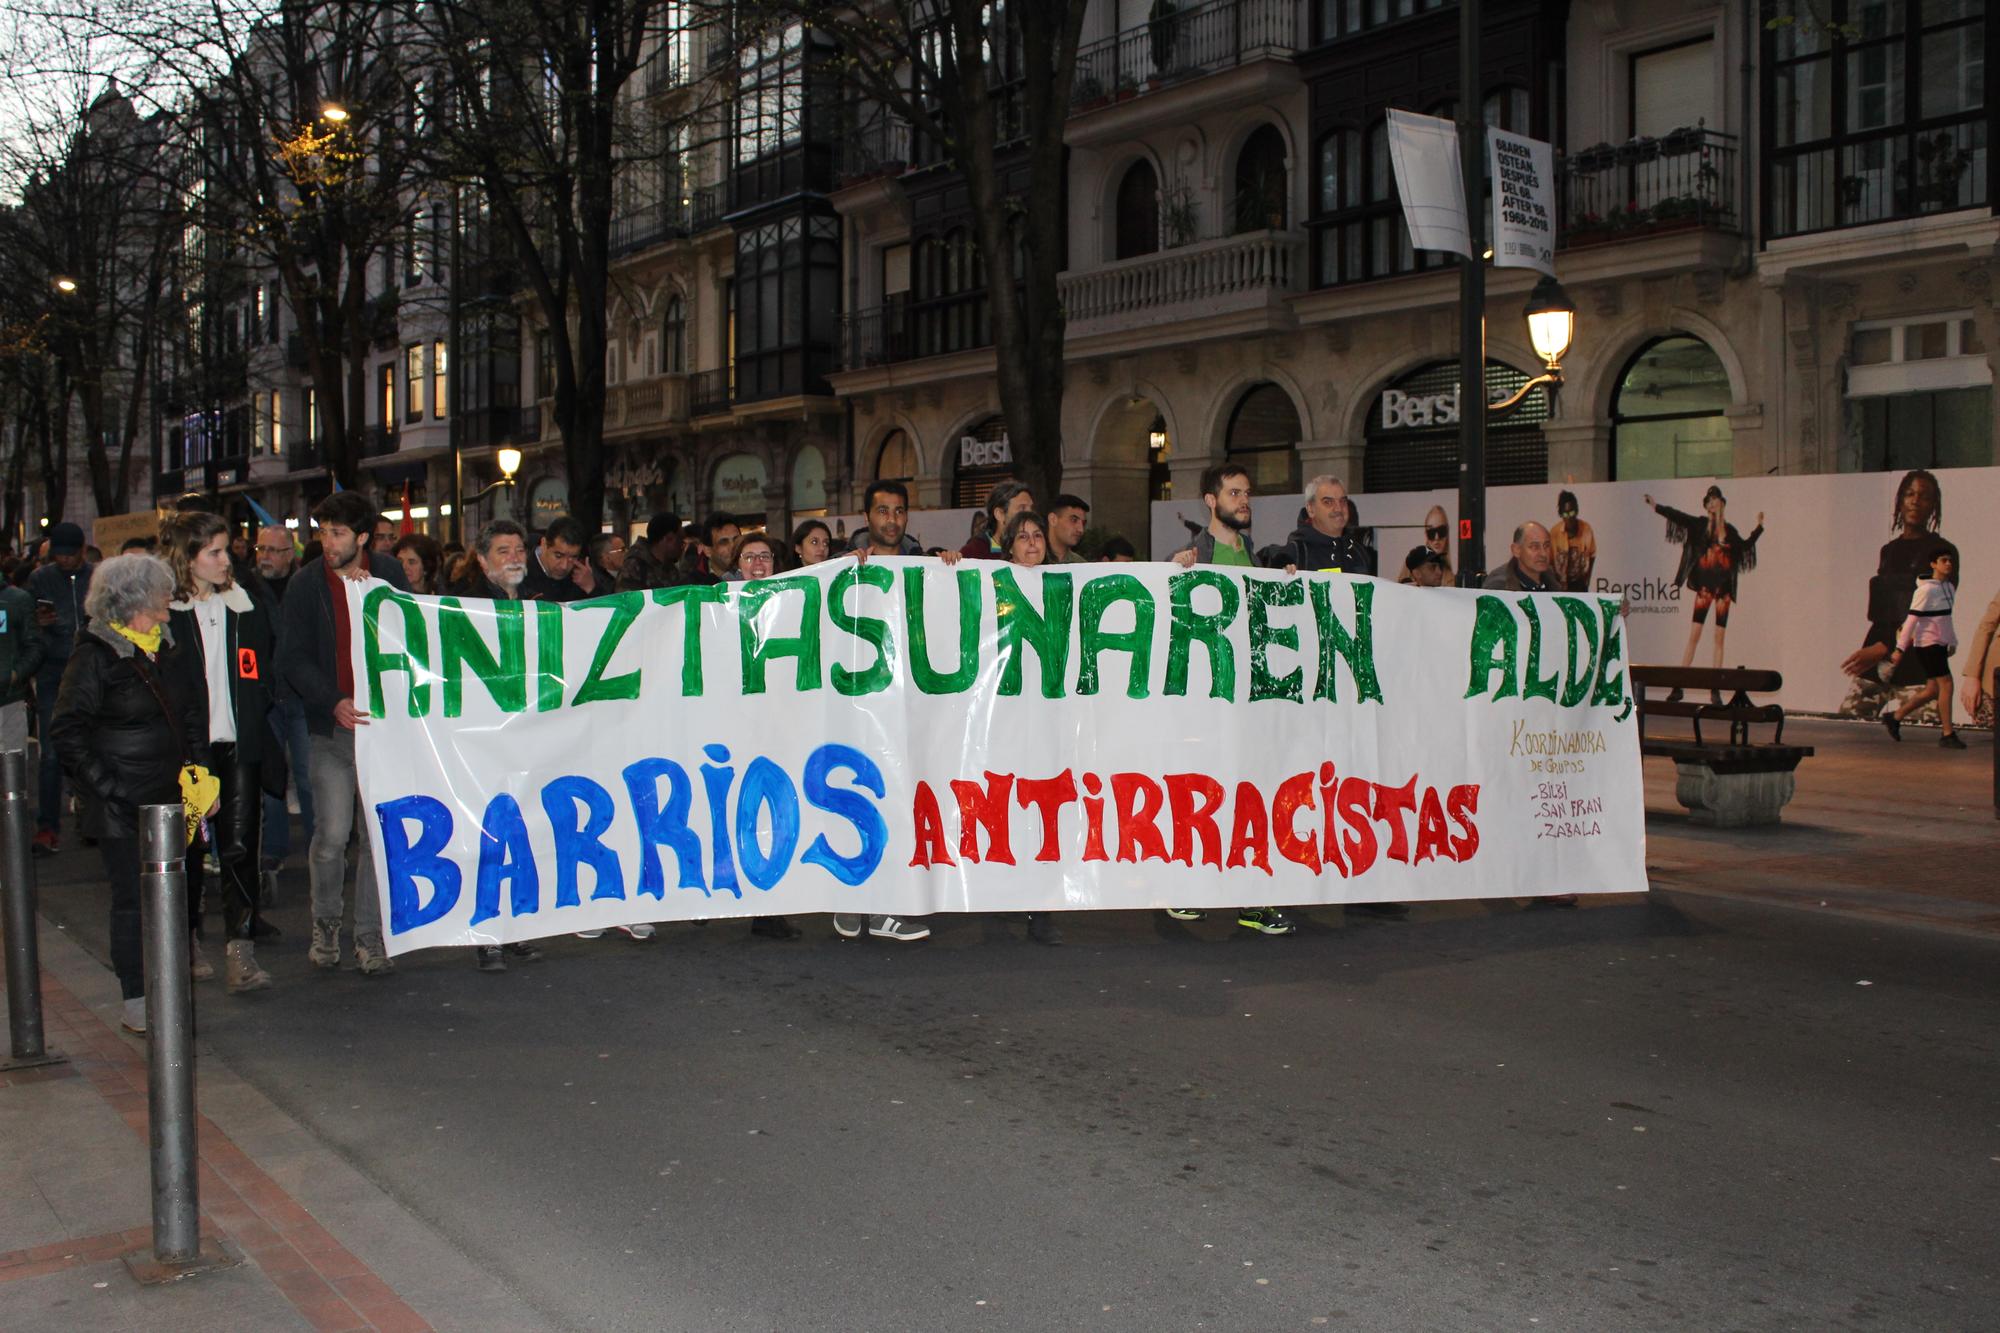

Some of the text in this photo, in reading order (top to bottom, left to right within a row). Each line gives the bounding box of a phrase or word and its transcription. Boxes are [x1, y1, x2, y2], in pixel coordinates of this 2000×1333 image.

[1502, 181, 1519, 196] DEL
[1502, 195, 1532, 212] AFTER
[1502, 210, 1549, 232] 1968-2018
[363, 565, 1633, 723] ANIZTASUNAREN ALDE,
[1529, 759, 1542, 773] DE
[1570, 797, 1602, 817] FRAN
